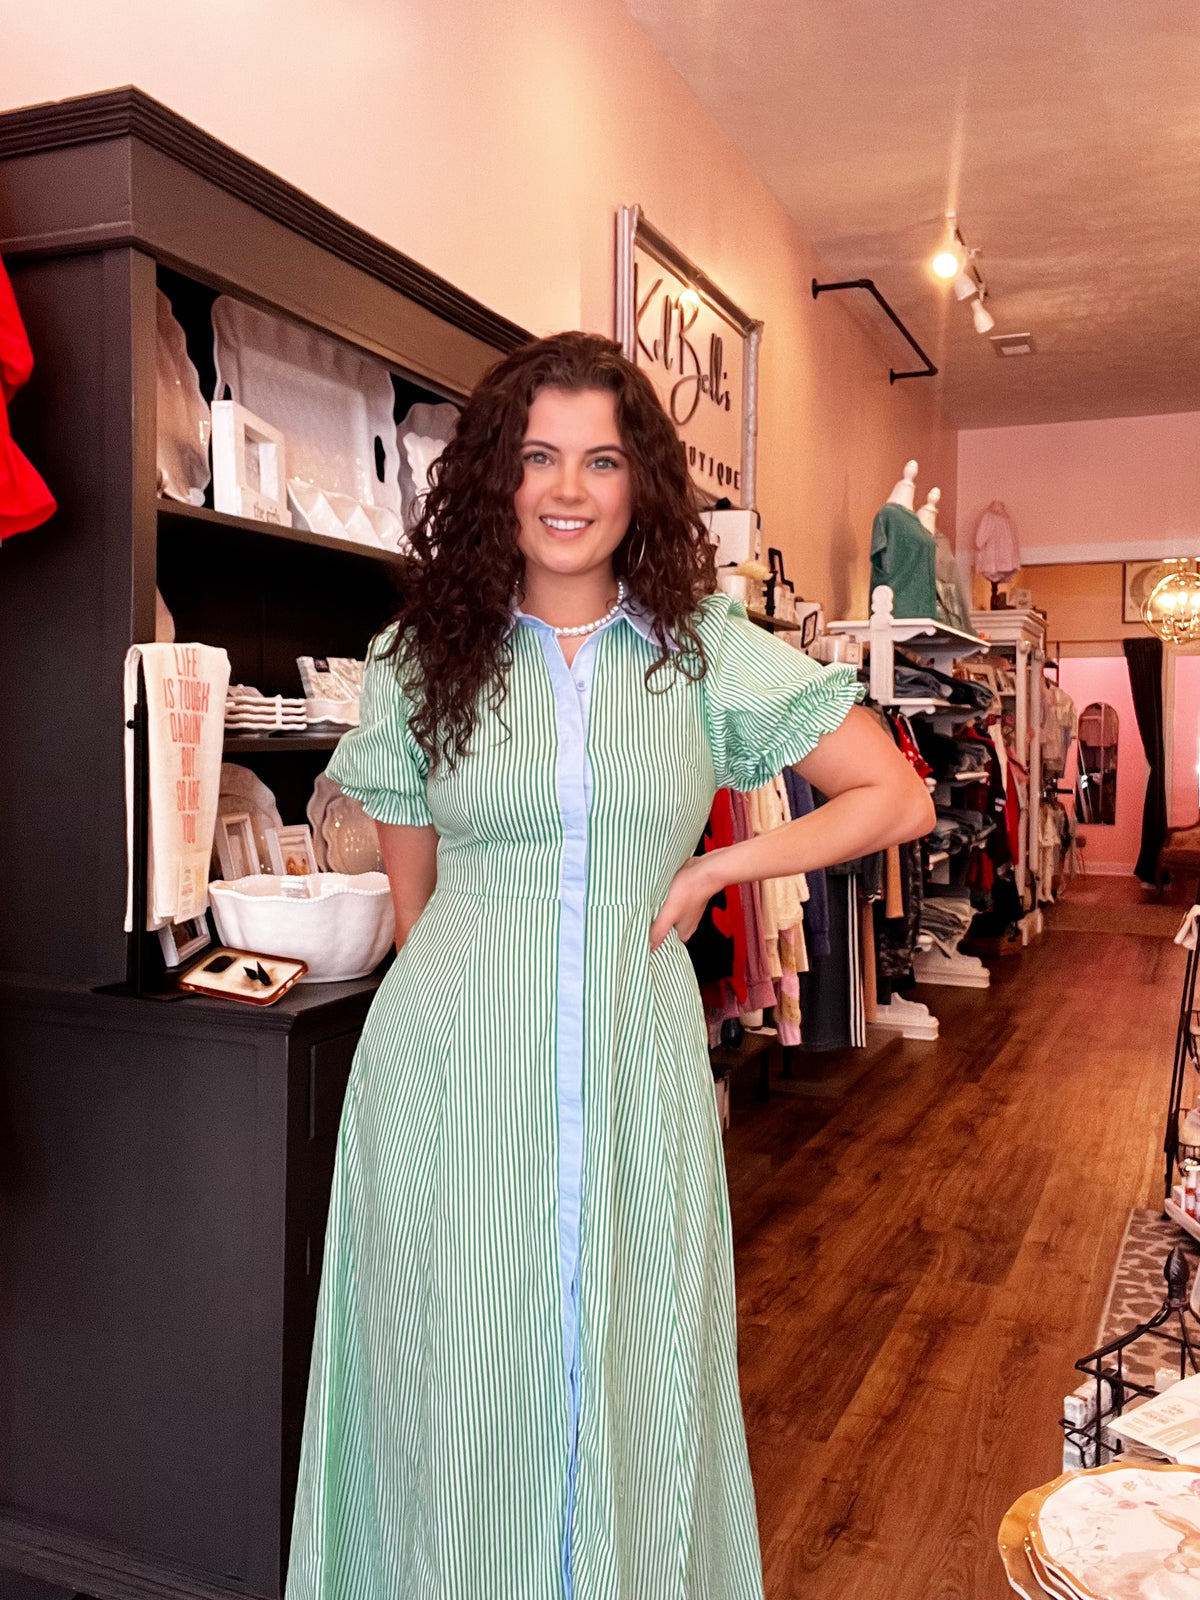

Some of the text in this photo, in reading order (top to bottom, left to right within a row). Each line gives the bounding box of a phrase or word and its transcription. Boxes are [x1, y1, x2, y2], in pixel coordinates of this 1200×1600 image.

[680, 441, 741, 490] UTIQUE
[173, 646, 198, 678] LIFE
[163, 678, 210, 713] IS TOUGH
[181, 747, 195, 777] BUT
[176, 780, 200, 811] SO ARE
[182, 814, 196, 844] YOU
